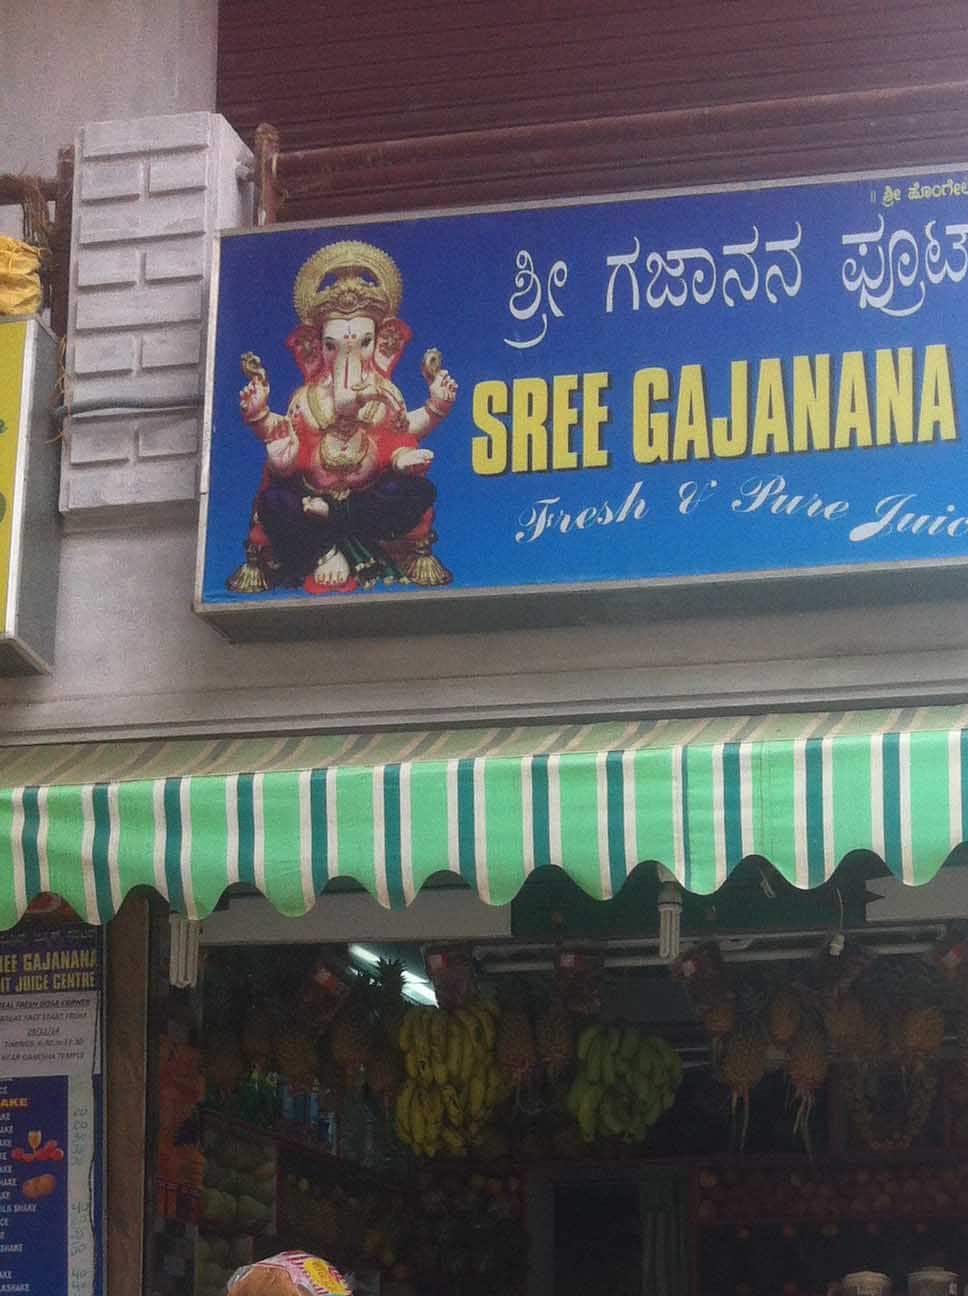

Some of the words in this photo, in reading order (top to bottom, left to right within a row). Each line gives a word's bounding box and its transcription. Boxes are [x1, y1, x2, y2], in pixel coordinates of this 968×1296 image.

[504, 250, 568, 350] ಶ್ರೀ
[605, 221, 803, 313] ಗಜಾನನ
[471, 372, 610, 476] SREE
[632, 344, 958, 465] GAJANANA
[515, 480, 648, 545] Fresh
[730, 472, 850, 521] Pure
[16, 974, 49, 993] JUICE
